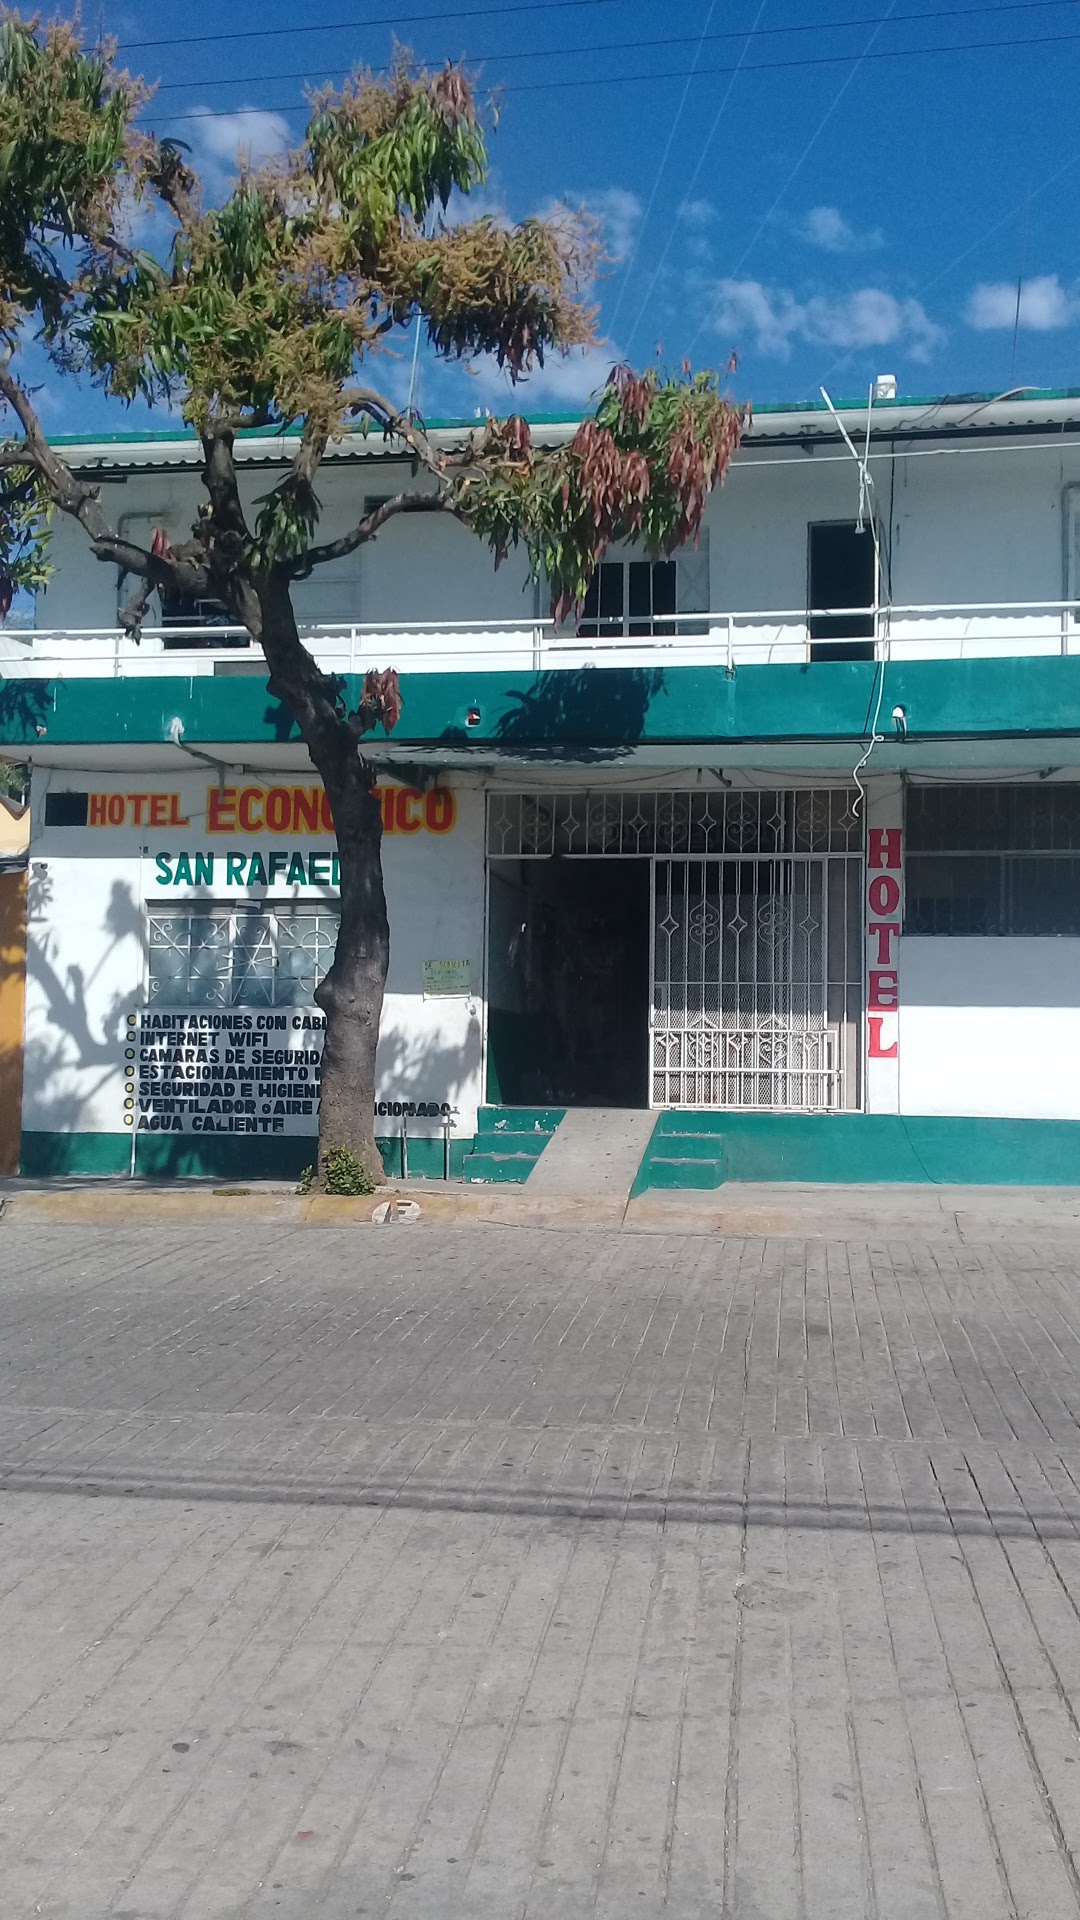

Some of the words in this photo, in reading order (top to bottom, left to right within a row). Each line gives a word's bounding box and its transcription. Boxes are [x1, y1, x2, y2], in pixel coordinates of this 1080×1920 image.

[89, 794, 189, 827] HOTEL
[207, 786, 455, 833] ECONICO
[155, 851, 214, 886] SAN
[867, 828, 902, 1057] HOTEL
[140, 1014, 253, 1030] HABITACIONES
[256, 1015, 287, 1030] CON
[140, 1032, 220, 1047] INTERNET
[228, 1032, 268, 1047] WIFI
[139, 1049, 220, 1064] CAMARAS
[225, 1049, 245, 1064] DE
[251, 1050, 323, 1065] SEGURID
[139, 1065, 309, 1081] ESTACIONAMIENTO
[139, 1082, 235, 1097] SEGURIDAD
[240, 1083, 253, 1097] E
[138, 1099, 257, 1114] VENTILADOR
[272, 1101, 312, 1115] AIRE
[137, 1115, 183, 1131] AGUA
[192, 1116, 284, 1132] CALIENTE
